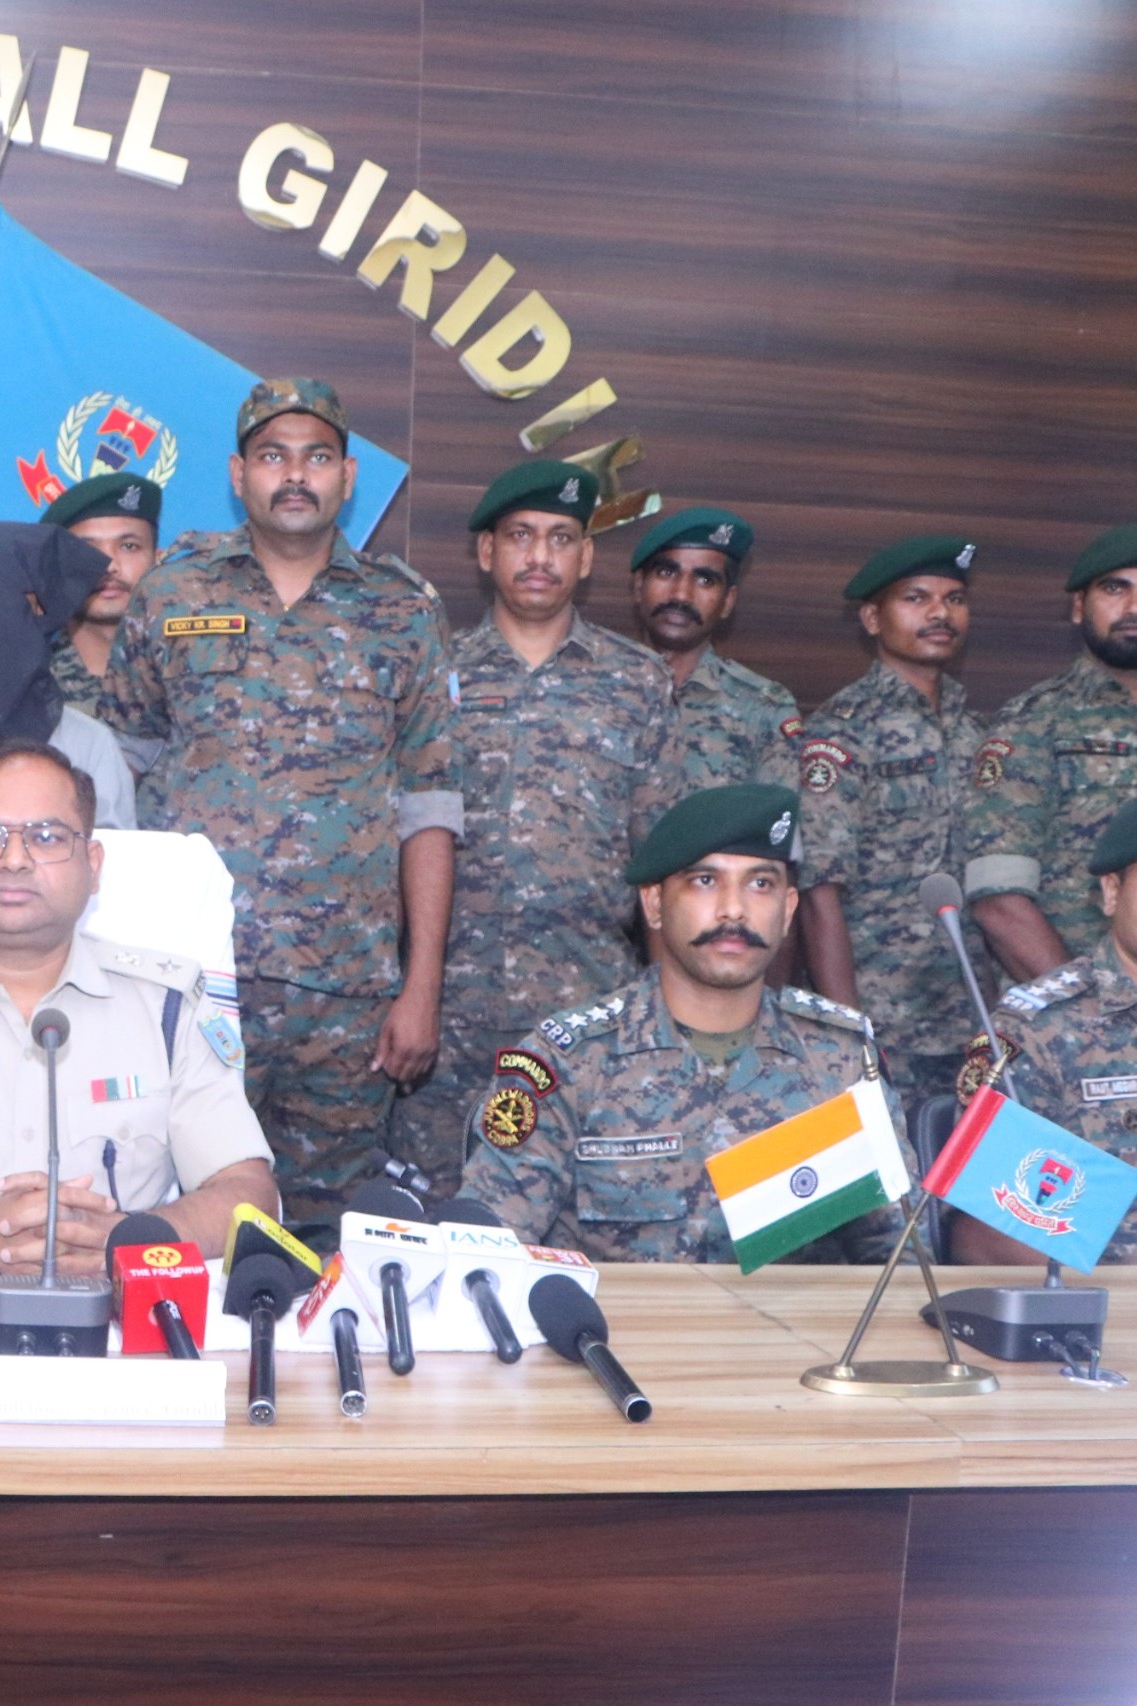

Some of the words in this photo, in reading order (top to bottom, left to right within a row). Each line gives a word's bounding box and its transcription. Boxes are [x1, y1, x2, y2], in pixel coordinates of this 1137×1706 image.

[541, 1018, 572, 1046] CRP
[499, 1053, 551, 1091] COMMANDO
[450, 1230, 519, 1248] IANS
[129, 1268, 150, 1277] THE
